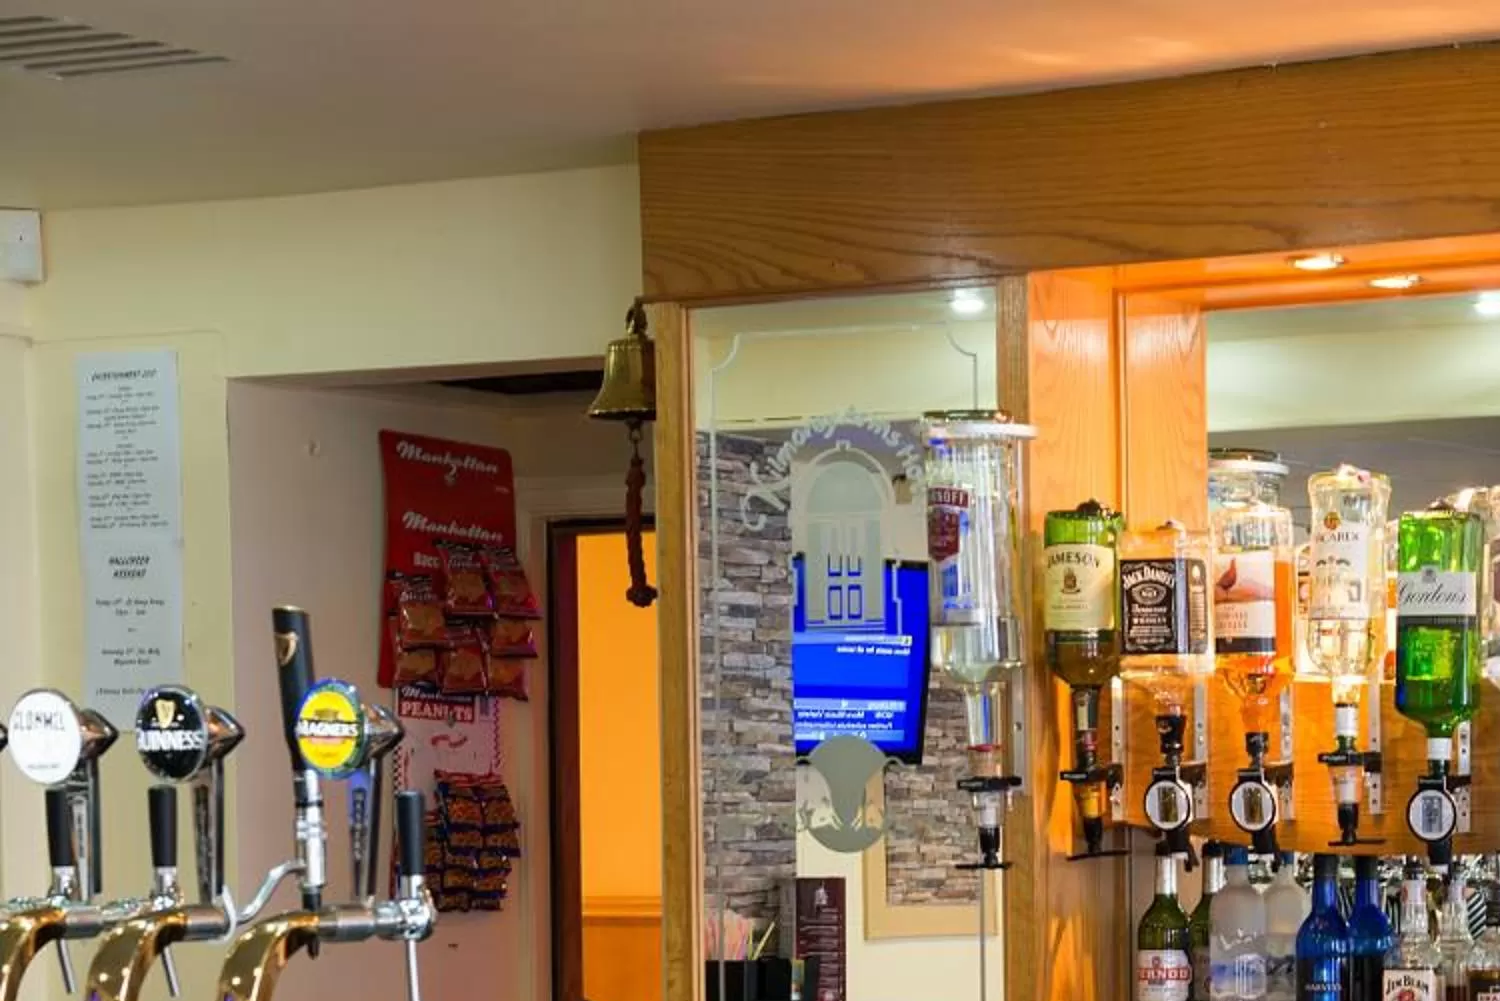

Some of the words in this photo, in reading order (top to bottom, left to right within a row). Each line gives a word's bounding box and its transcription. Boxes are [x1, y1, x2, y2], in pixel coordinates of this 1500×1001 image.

[402, 510, 503, 543] Manhattan
[1047, 551, 1100, 569] JAMESON
[137, 729, 206, 751] GUINNESS
